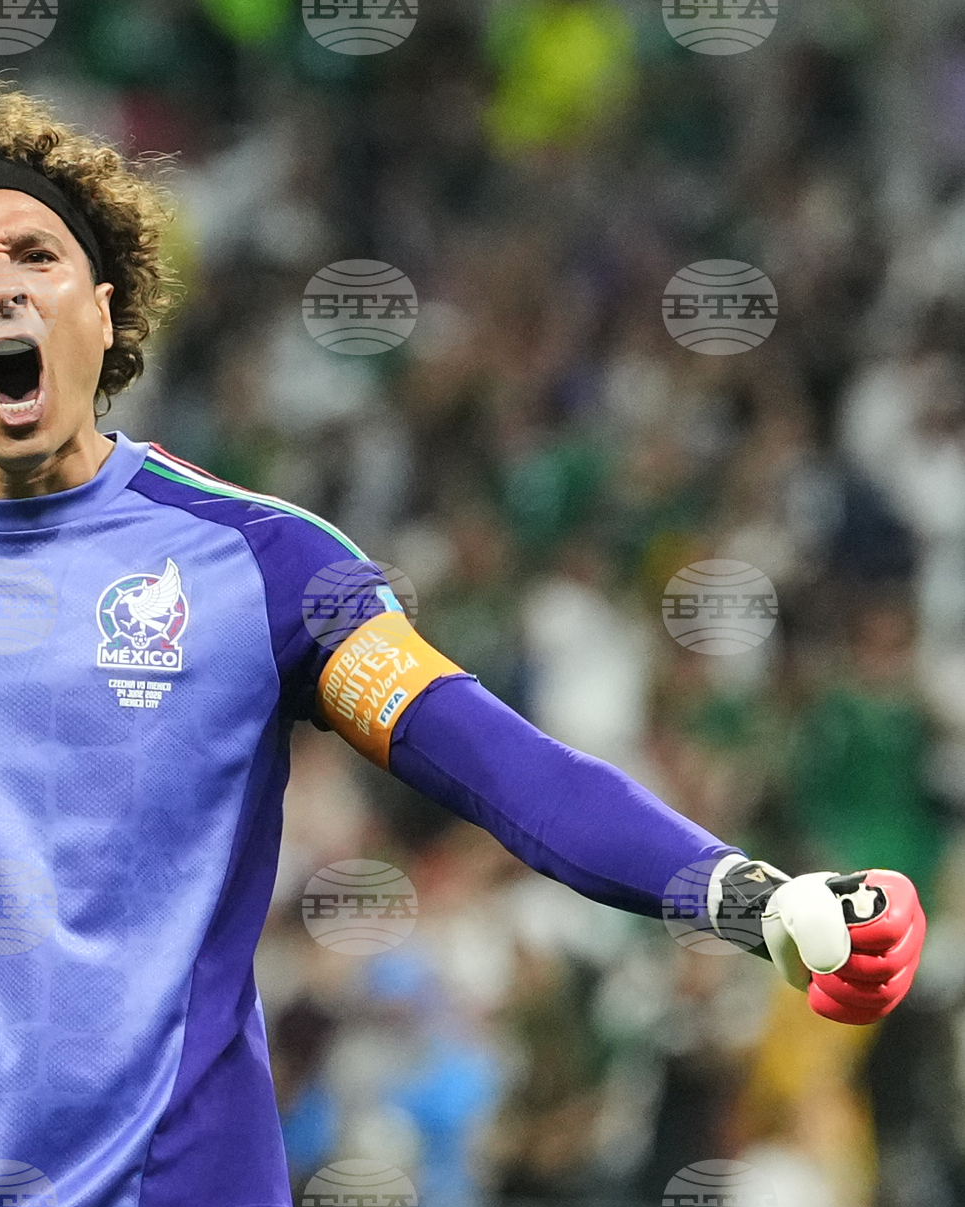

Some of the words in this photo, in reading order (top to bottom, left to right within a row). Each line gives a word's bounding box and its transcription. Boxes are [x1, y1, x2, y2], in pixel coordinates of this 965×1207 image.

[101, 646, 177, 667] MÉXICO
[322, 630, 383, 707] FOOTBALL
[336, 641, 400, 720] UNITES
[144, 690, 162, 700] 2026
[355, 708, 372, 736] the
[364, 652, 419, 708] World
[379, 692, 404, 723] FIFA
